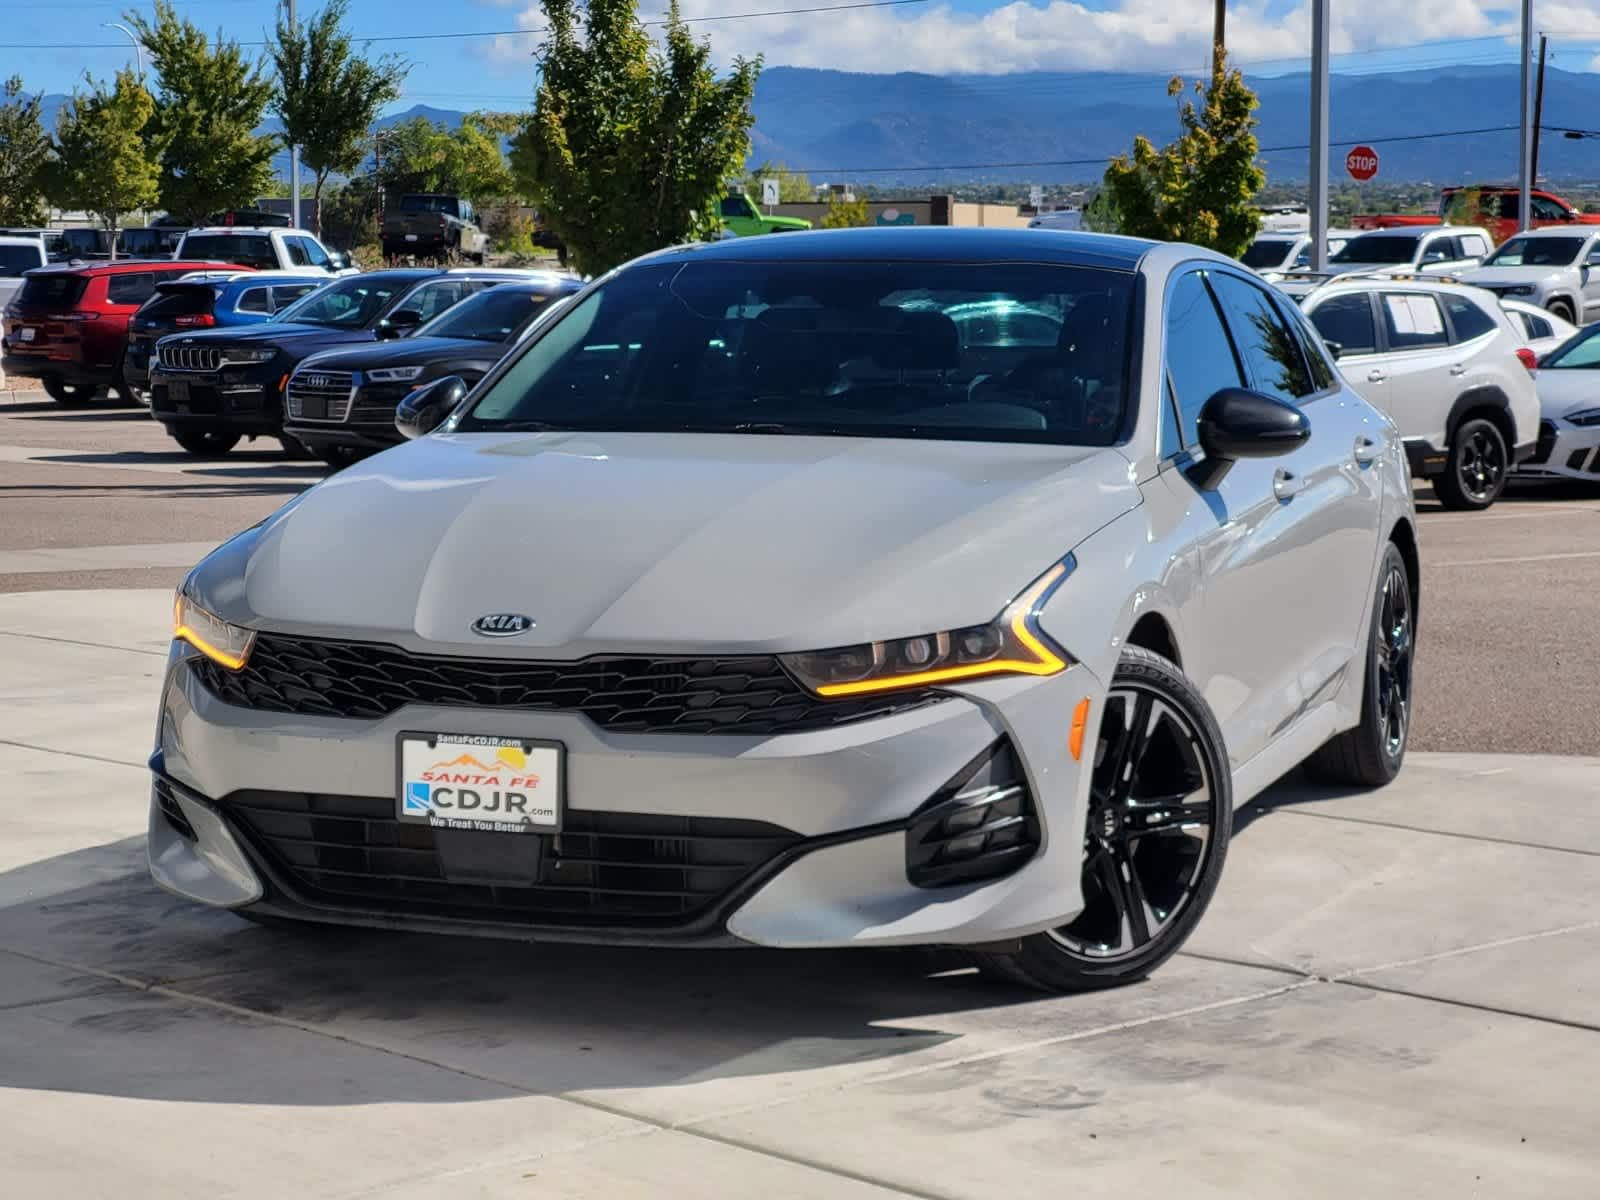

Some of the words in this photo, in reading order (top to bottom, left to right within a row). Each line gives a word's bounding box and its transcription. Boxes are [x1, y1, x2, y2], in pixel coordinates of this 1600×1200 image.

[1348, 155, 1377, 170] STOP
[481, 615, 522, 630] KIA
[421, 772, 500, 786] SANTA
[510, 776, 539, 789] FE
[429, 817, 445, 827] We
[447, 819, 472, 830] Treat
[473, 820, 493, 831] You
[494, 822, 526, 833] Better
